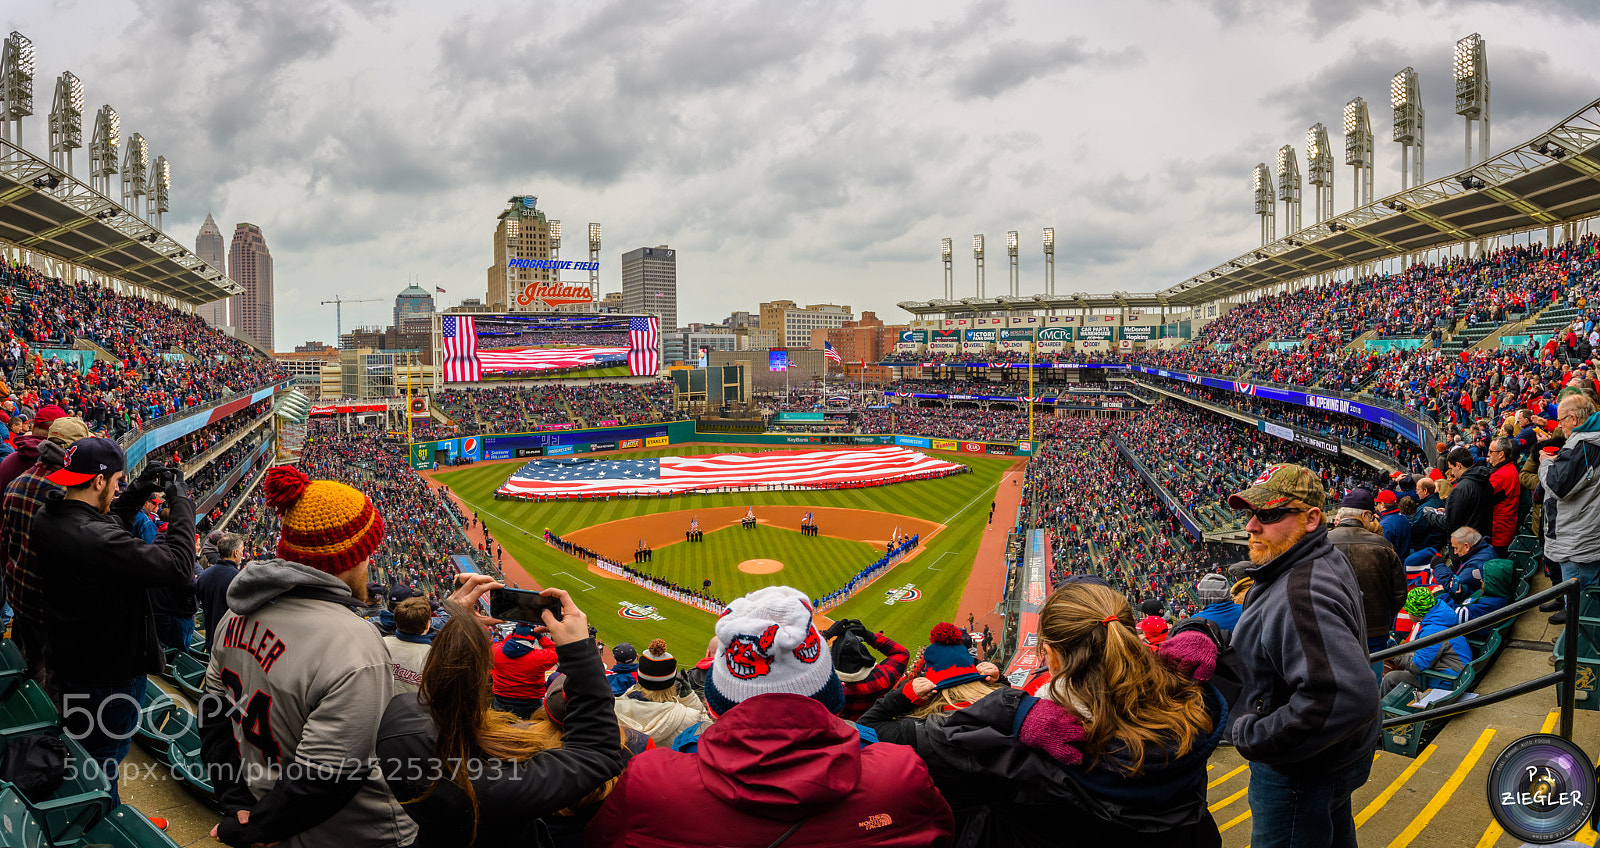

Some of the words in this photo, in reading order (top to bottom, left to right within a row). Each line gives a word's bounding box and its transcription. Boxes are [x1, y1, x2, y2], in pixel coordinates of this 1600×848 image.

[508, 259, 573, 270] PROGRESSIVE
[574, 262, 599, 271] FIELD
[517, 282, 593, 306] Indians
[1044, 331, 1071, 339] MCPc
[1316, 396, 1339, 412] OPENING
[1339, 401, 1350, 414] DAY
[1309, 438, 1326, 450] INFINITI
[1326, 443, 1338, 453] CLUB
[418, 449, 427, 457] 811
[618, 601, 652, 615] OPENING
[223, 616, 286, 674] MILLER
[858, 819, 881, 827] NORTH
